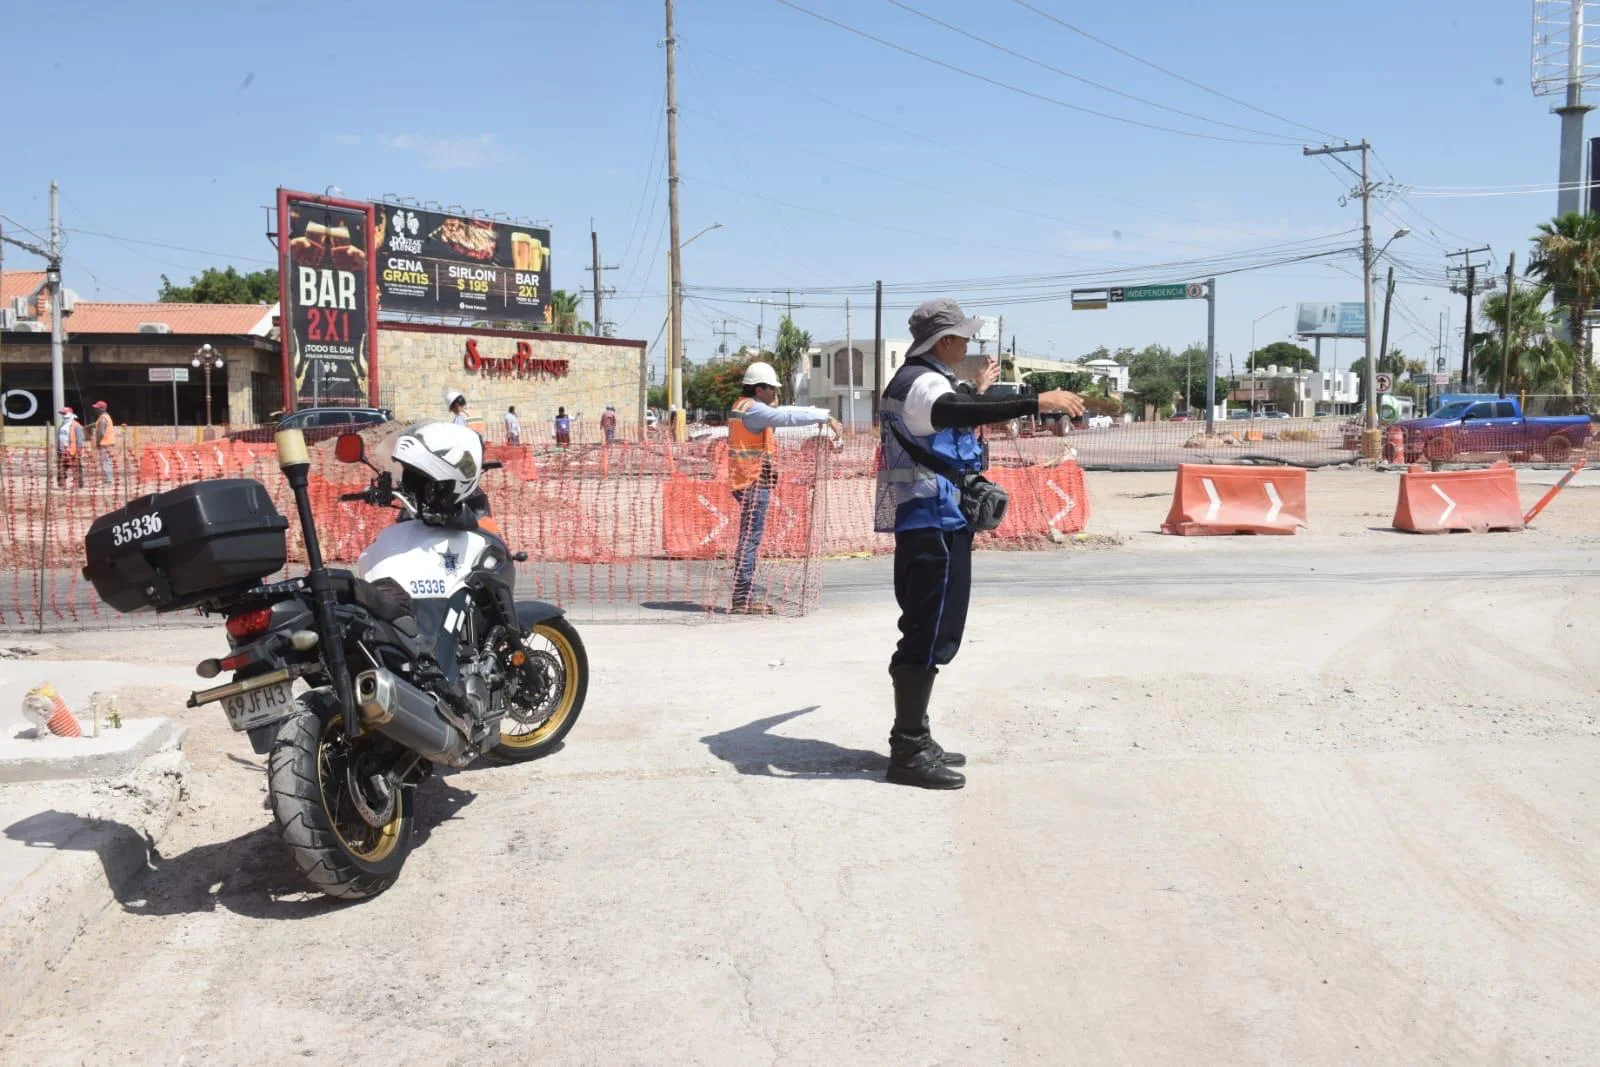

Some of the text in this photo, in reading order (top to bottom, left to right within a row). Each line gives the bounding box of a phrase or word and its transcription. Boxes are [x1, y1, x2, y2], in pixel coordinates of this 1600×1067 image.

[388, 257, 424, 273] CENA
[383, 269, 429, 285] GRATIS
[448, 265, 497, 282] SIRLOIN
[515, 272, 540, 287] BAR
[298, 265, 357, 310] BAR
[468, 280, 489, 292] 195
[518, 285, 537, 298] 2X1
[1127, 287, 1184, 298] INDEPENDENCIA
[307, 308, 350, 342] 2X1
[329, 345, 339, 353] EL
[112, 511, 162, 546] 35336
[410, 579, 446, 594] 35336
